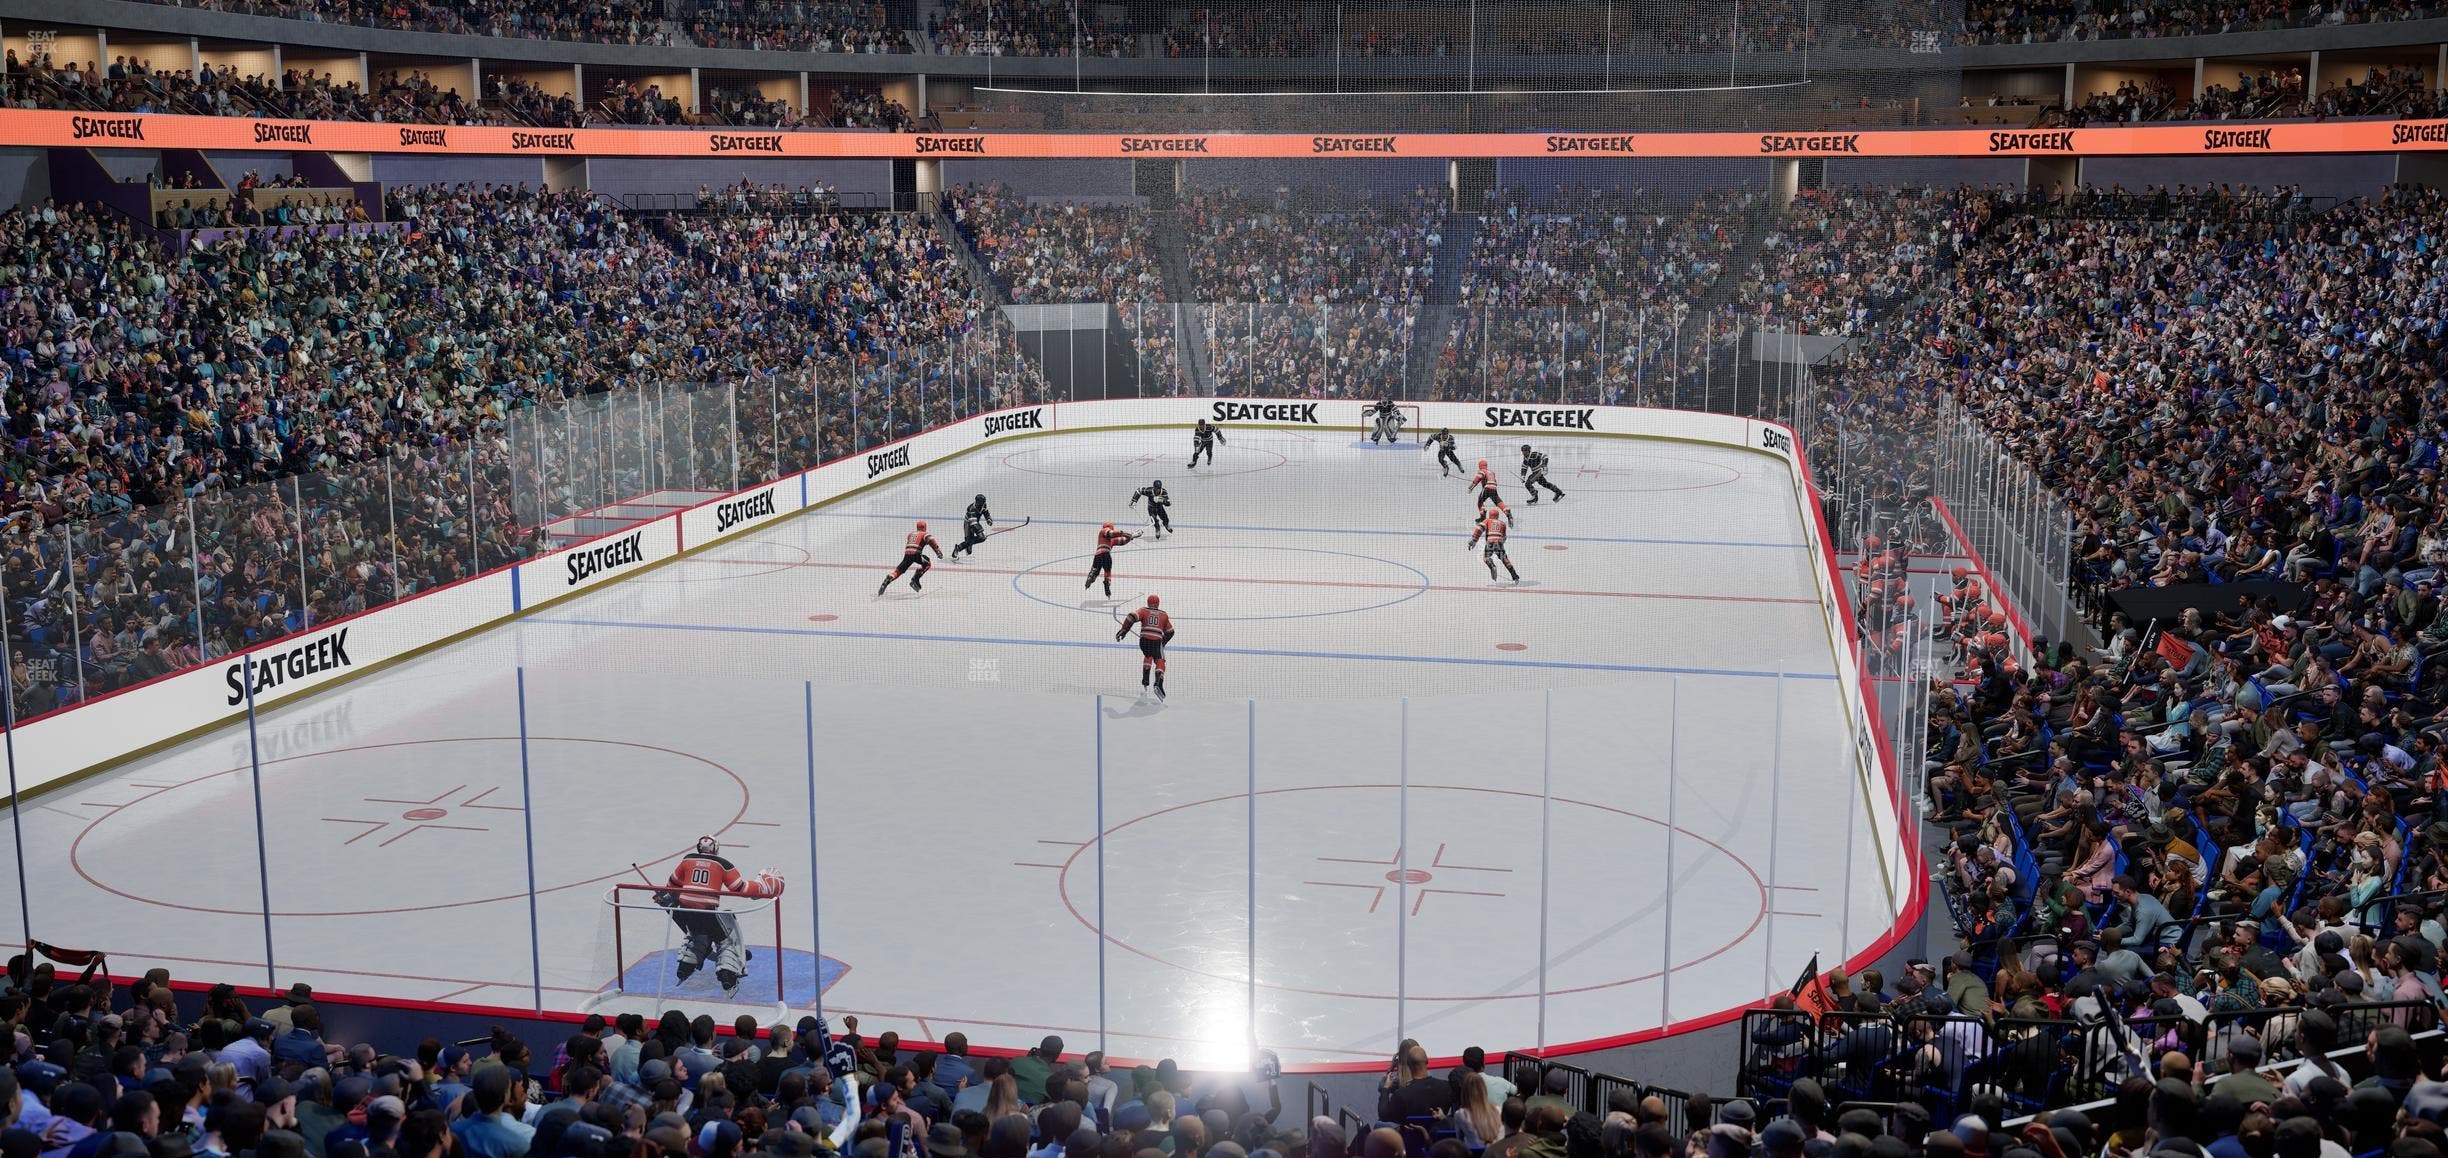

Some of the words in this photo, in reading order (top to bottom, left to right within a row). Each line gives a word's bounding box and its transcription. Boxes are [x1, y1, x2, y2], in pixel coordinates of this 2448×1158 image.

[73, 116, 144, 140] SEATGEEK
[254, 123, 311, 144] SEATGEEK
[400, 128, 446, 147] SEATGEEK
[512, 132, 574, 150] SEATGEEK
[710, 134, 783, 152] SEATGEEK
[915, 136, 984, 153] SEATGEEK
[1121, 138, 1208, 153] SEATGEEK
[1312, 137, 1397, 153] SEATGEEK
[1547, 136, 1633, 152] SEATGEEK
[1761, 134, 1859, 153] SEATGEEK
[1989, 131, 2074, 151] SEATGEEK
[2205, 128, 2271, 150] SEATGEEK
[984, 407, 1042, 438] SEATGEEK
[1213, 402, 1318, 424] SEATGEEK
[1485, 407, 1594, 430] SEATGEEK
[867, 444, 910, 479] SEATGEEK
[717, 487, 775, 533] SEATGEEK
[567, 531, 642, 586] SEATGEEK
[226, 627, 351, 706] SEATGEEK
[692, 868, 709, 885] 00
